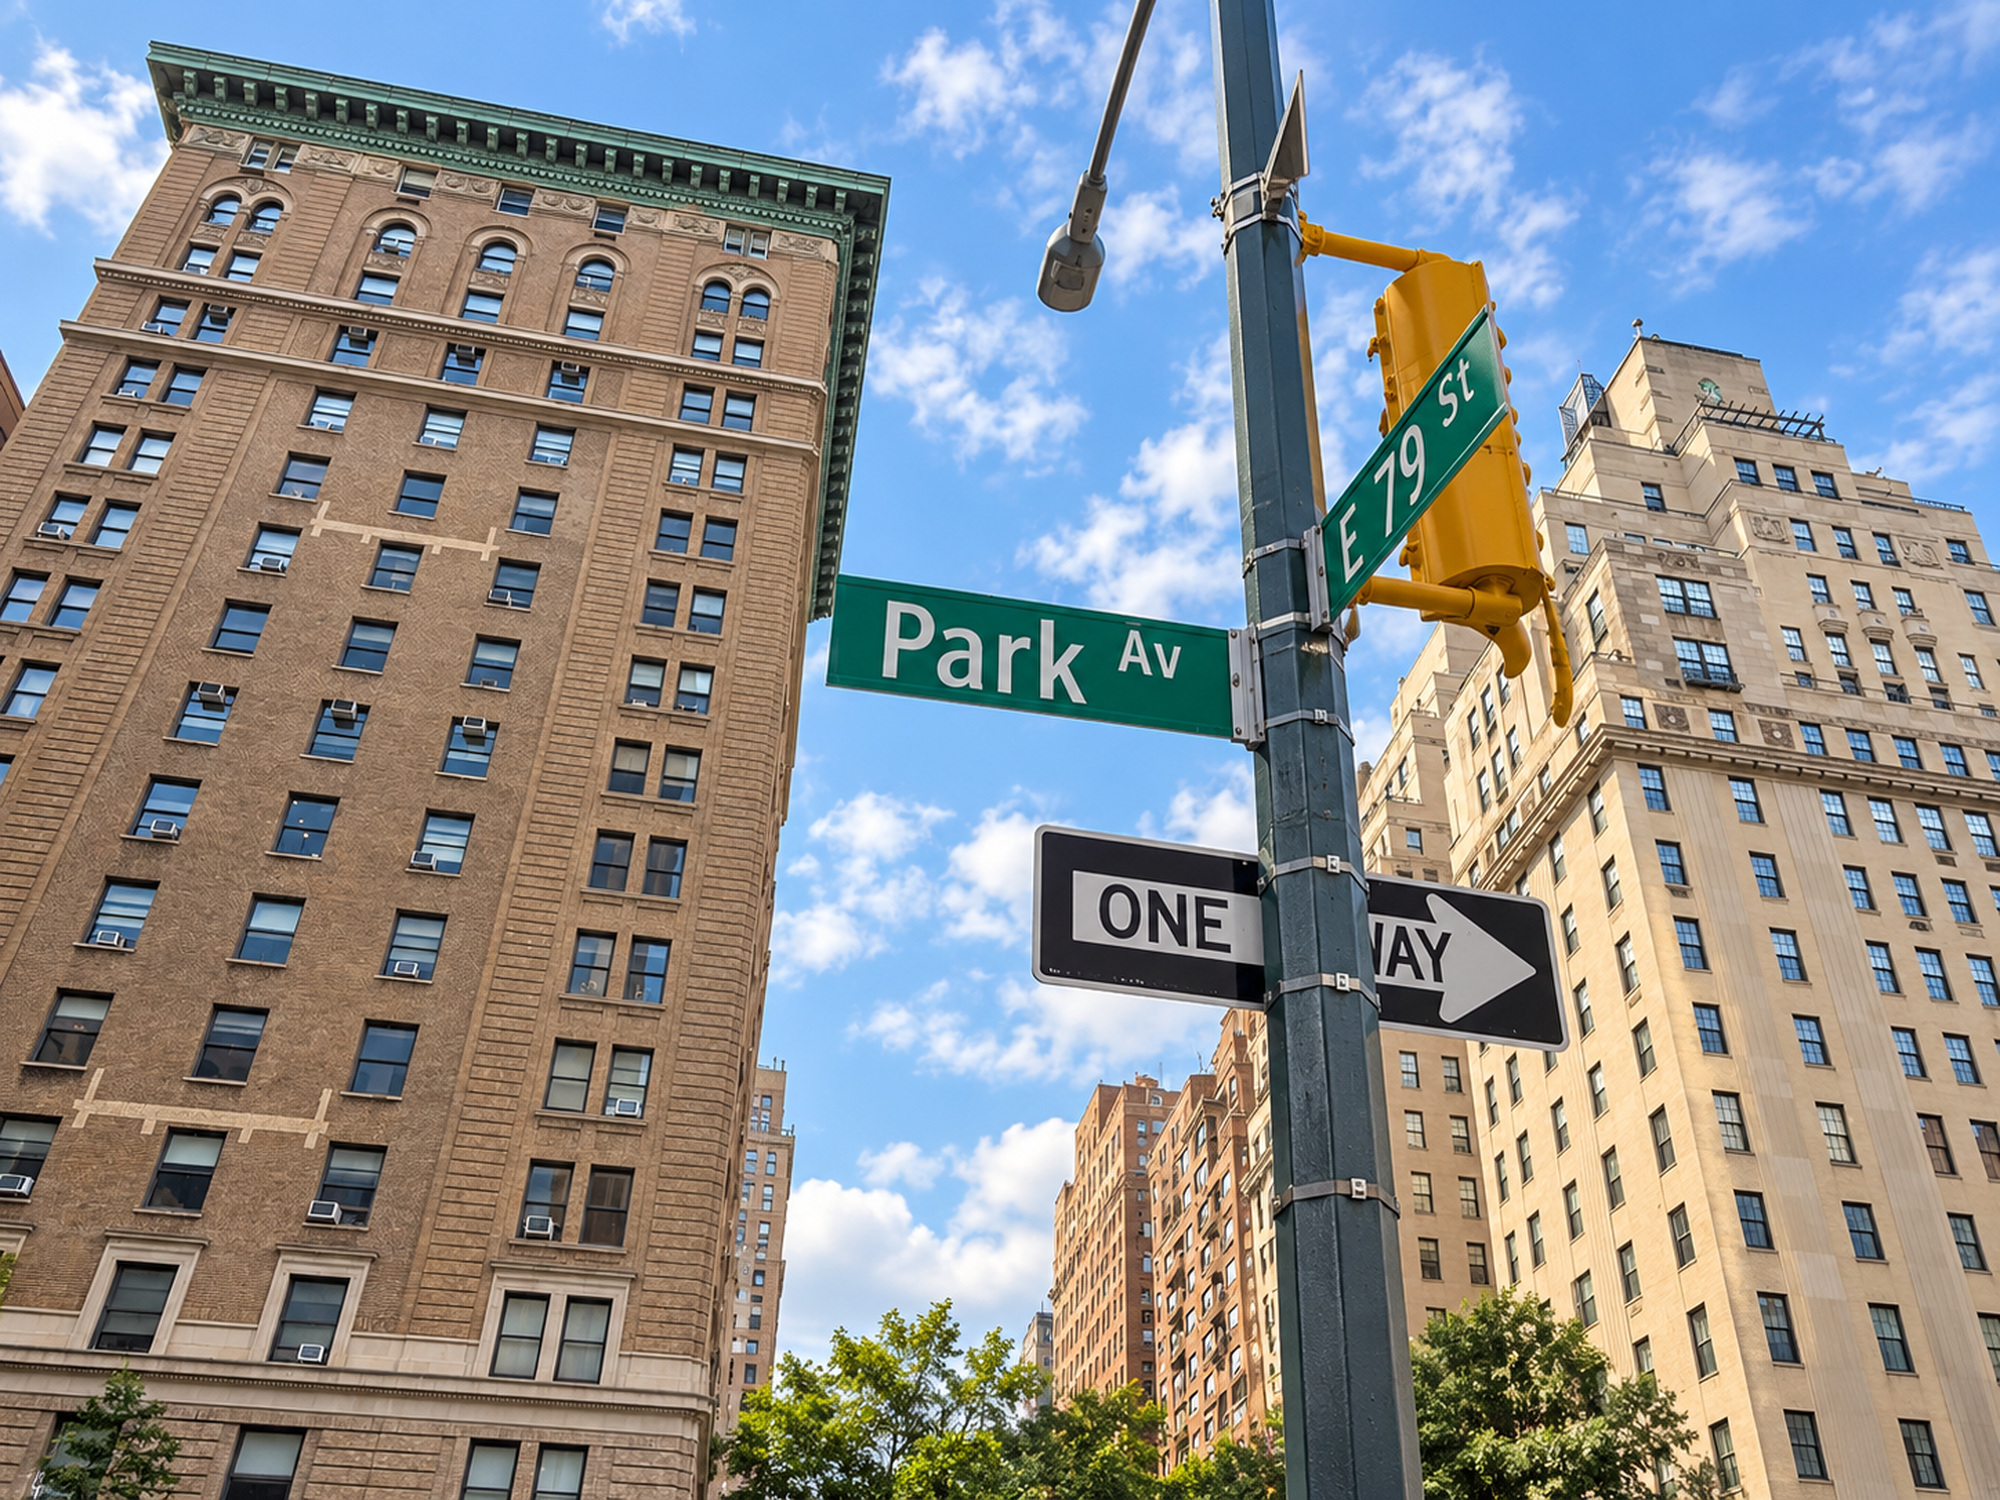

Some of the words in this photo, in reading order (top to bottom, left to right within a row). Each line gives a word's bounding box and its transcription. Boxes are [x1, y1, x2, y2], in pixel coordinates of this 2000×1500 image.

[1339, 503, 1364, 584] E
[1374, 424, 1426, 538] 79
[1438, 358, 1475, 428] St
[881, 600, 1087, 704] Park
[1118, 629, 1182, 679] Av
[1099, 884, 1231, 953] ONE
[1371, 922, 1452, 983] AY
